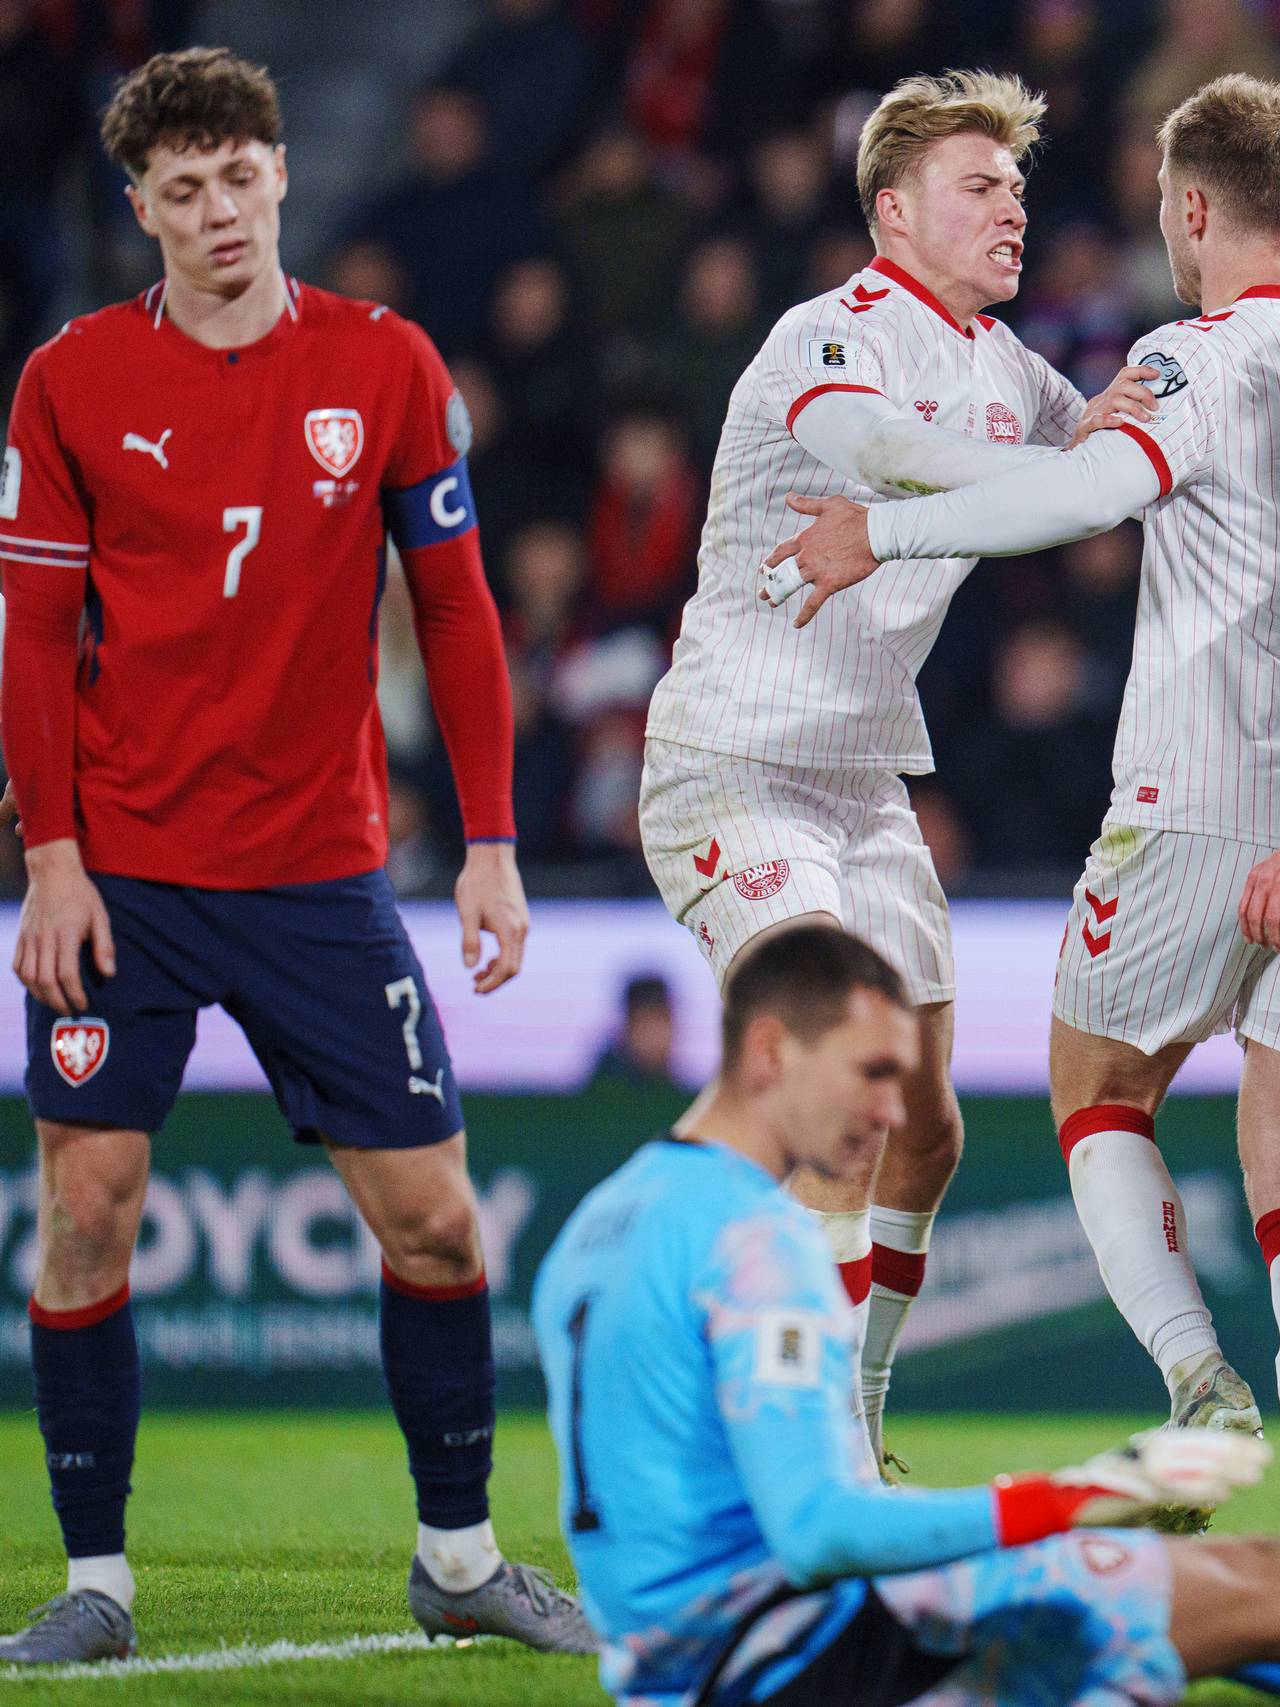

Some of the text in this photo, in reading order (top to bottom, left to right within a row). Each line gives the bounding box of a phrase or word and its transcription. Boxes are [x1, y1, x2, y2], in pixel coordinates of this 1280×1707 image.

[430, 476, 467, 528] C
[223, 506, 263, 598] 7
[385, 976, 423, 1070] 7
[1162, 1200, 1180, 1252] DANMARK
[565, 1294, 601, 1531] 1
